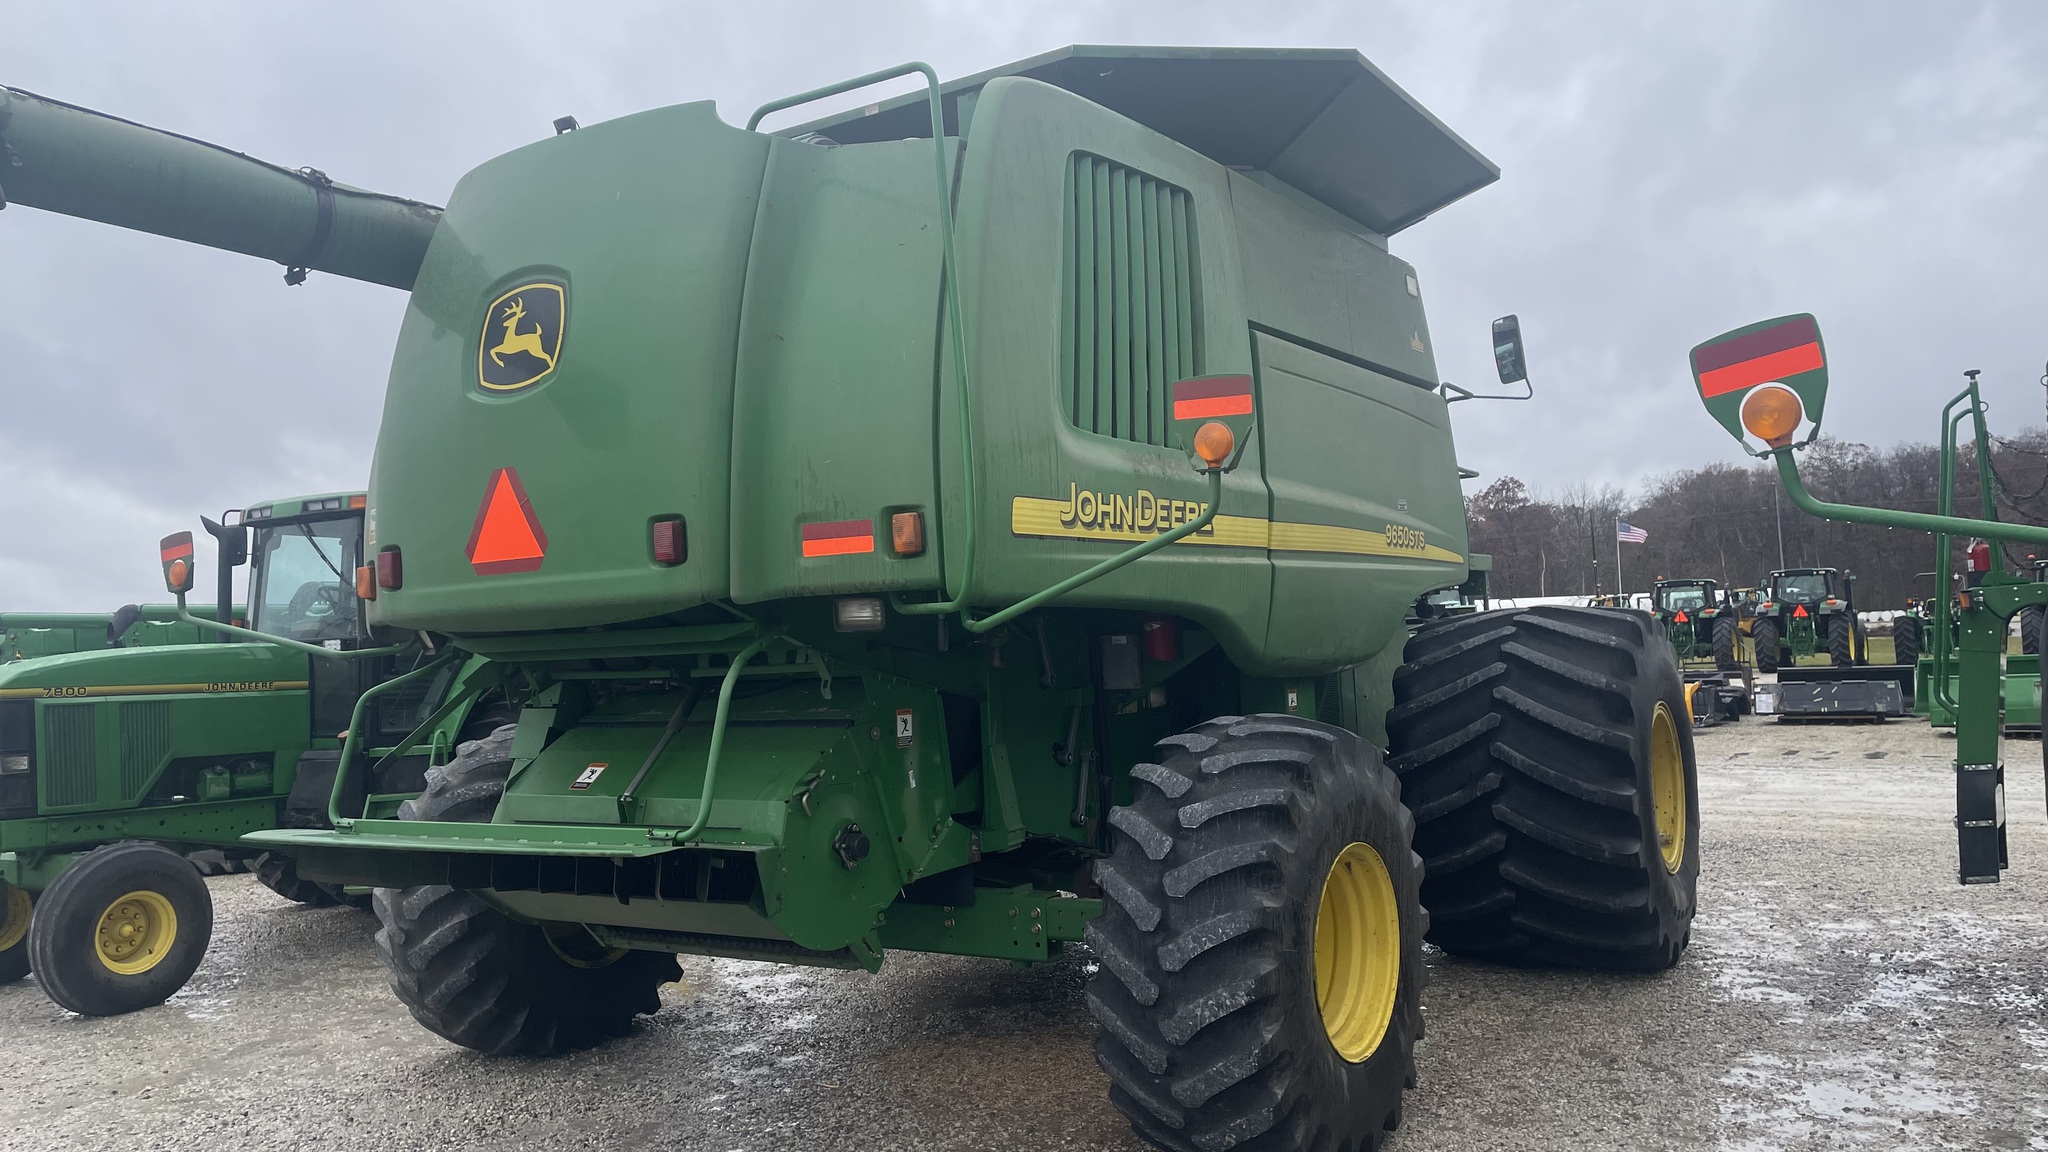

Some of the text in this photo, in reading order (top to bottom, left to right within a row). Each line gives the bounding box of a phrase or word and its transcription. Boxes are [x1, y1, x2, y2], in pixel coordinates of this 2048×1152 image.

[1060, 481, 1136, 533] JOHN
[42, 687, 88, 698] 7800
[203, 681, 276, 693] JOHN DEERE
